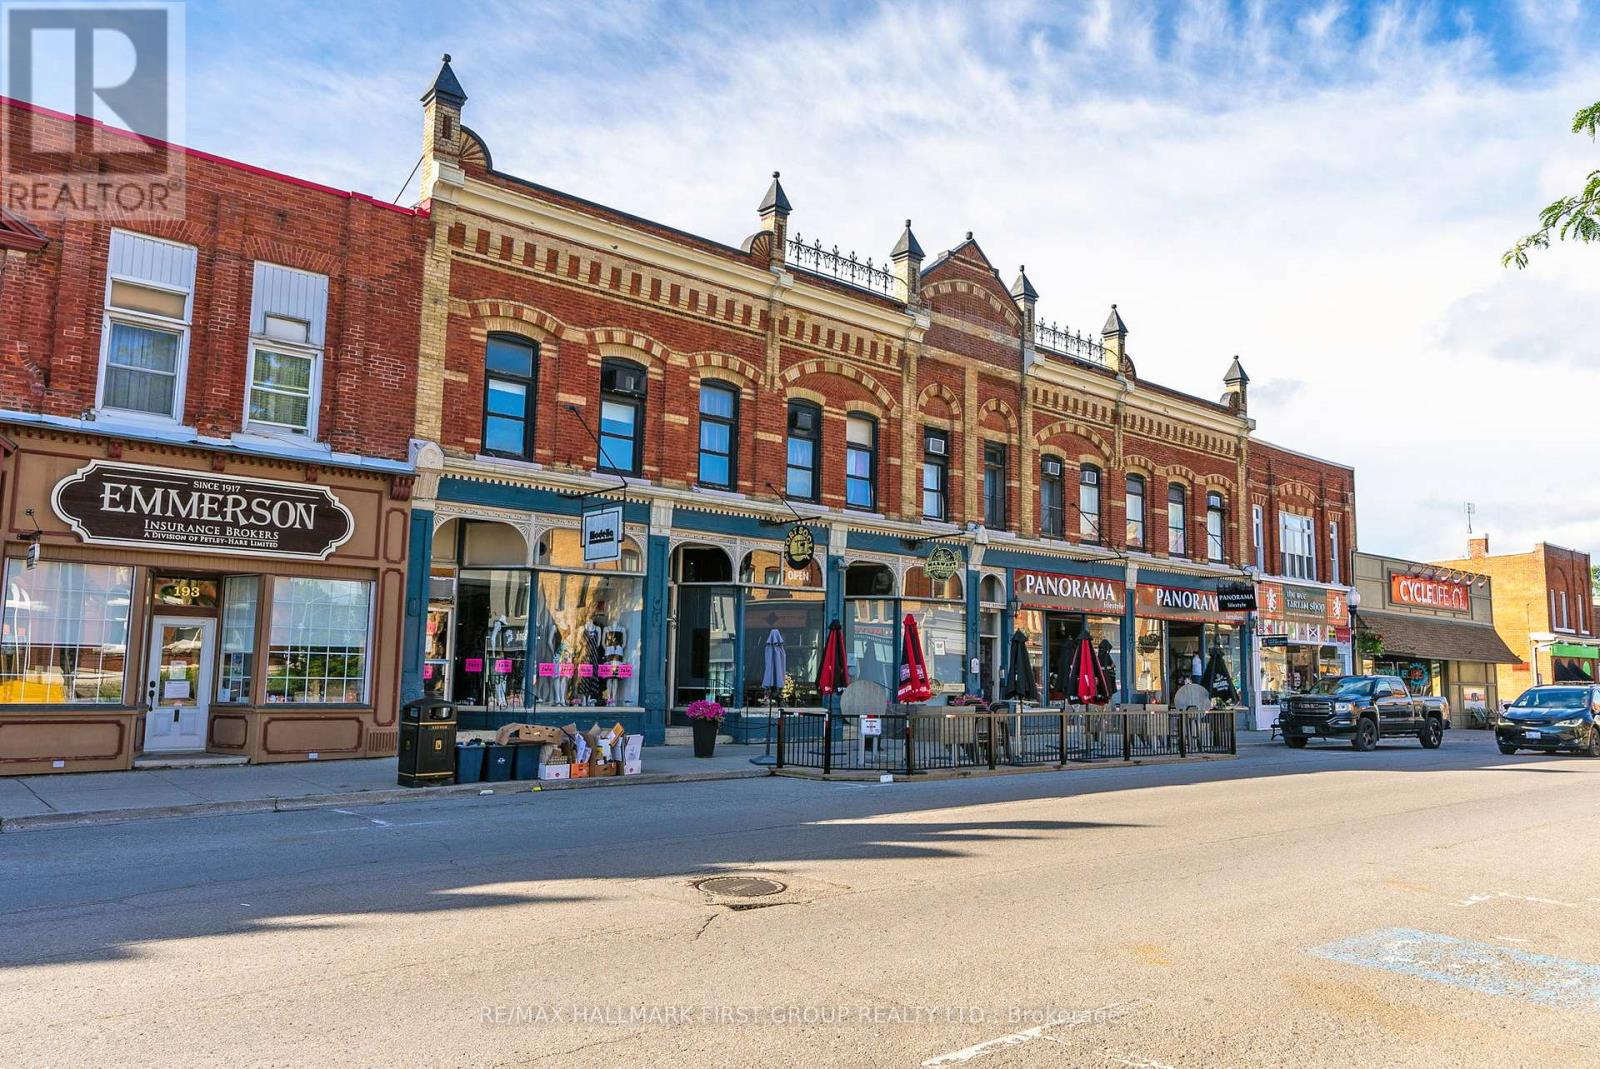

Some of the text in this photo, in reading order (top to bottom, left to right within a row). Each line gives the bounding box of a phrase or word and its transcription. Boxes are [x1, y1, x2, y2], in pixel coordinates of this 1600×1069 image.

[193, 481, 241, 493] SINCE 1917
[100, 482, 318, 530] EMMERSON
[144, 519, 279, 540] INSURANCE BROKERS
[152, 532, 186, 541] DIVISION
[788, 570, 809, 581] OPEN
[173, 586, 200, 597] 193
[1026, 574, 1115, 601] PANORAMA
[1156, 588, 1219, 611] PANORAM
[1219, 593, 1254, 601] PANORAMA
